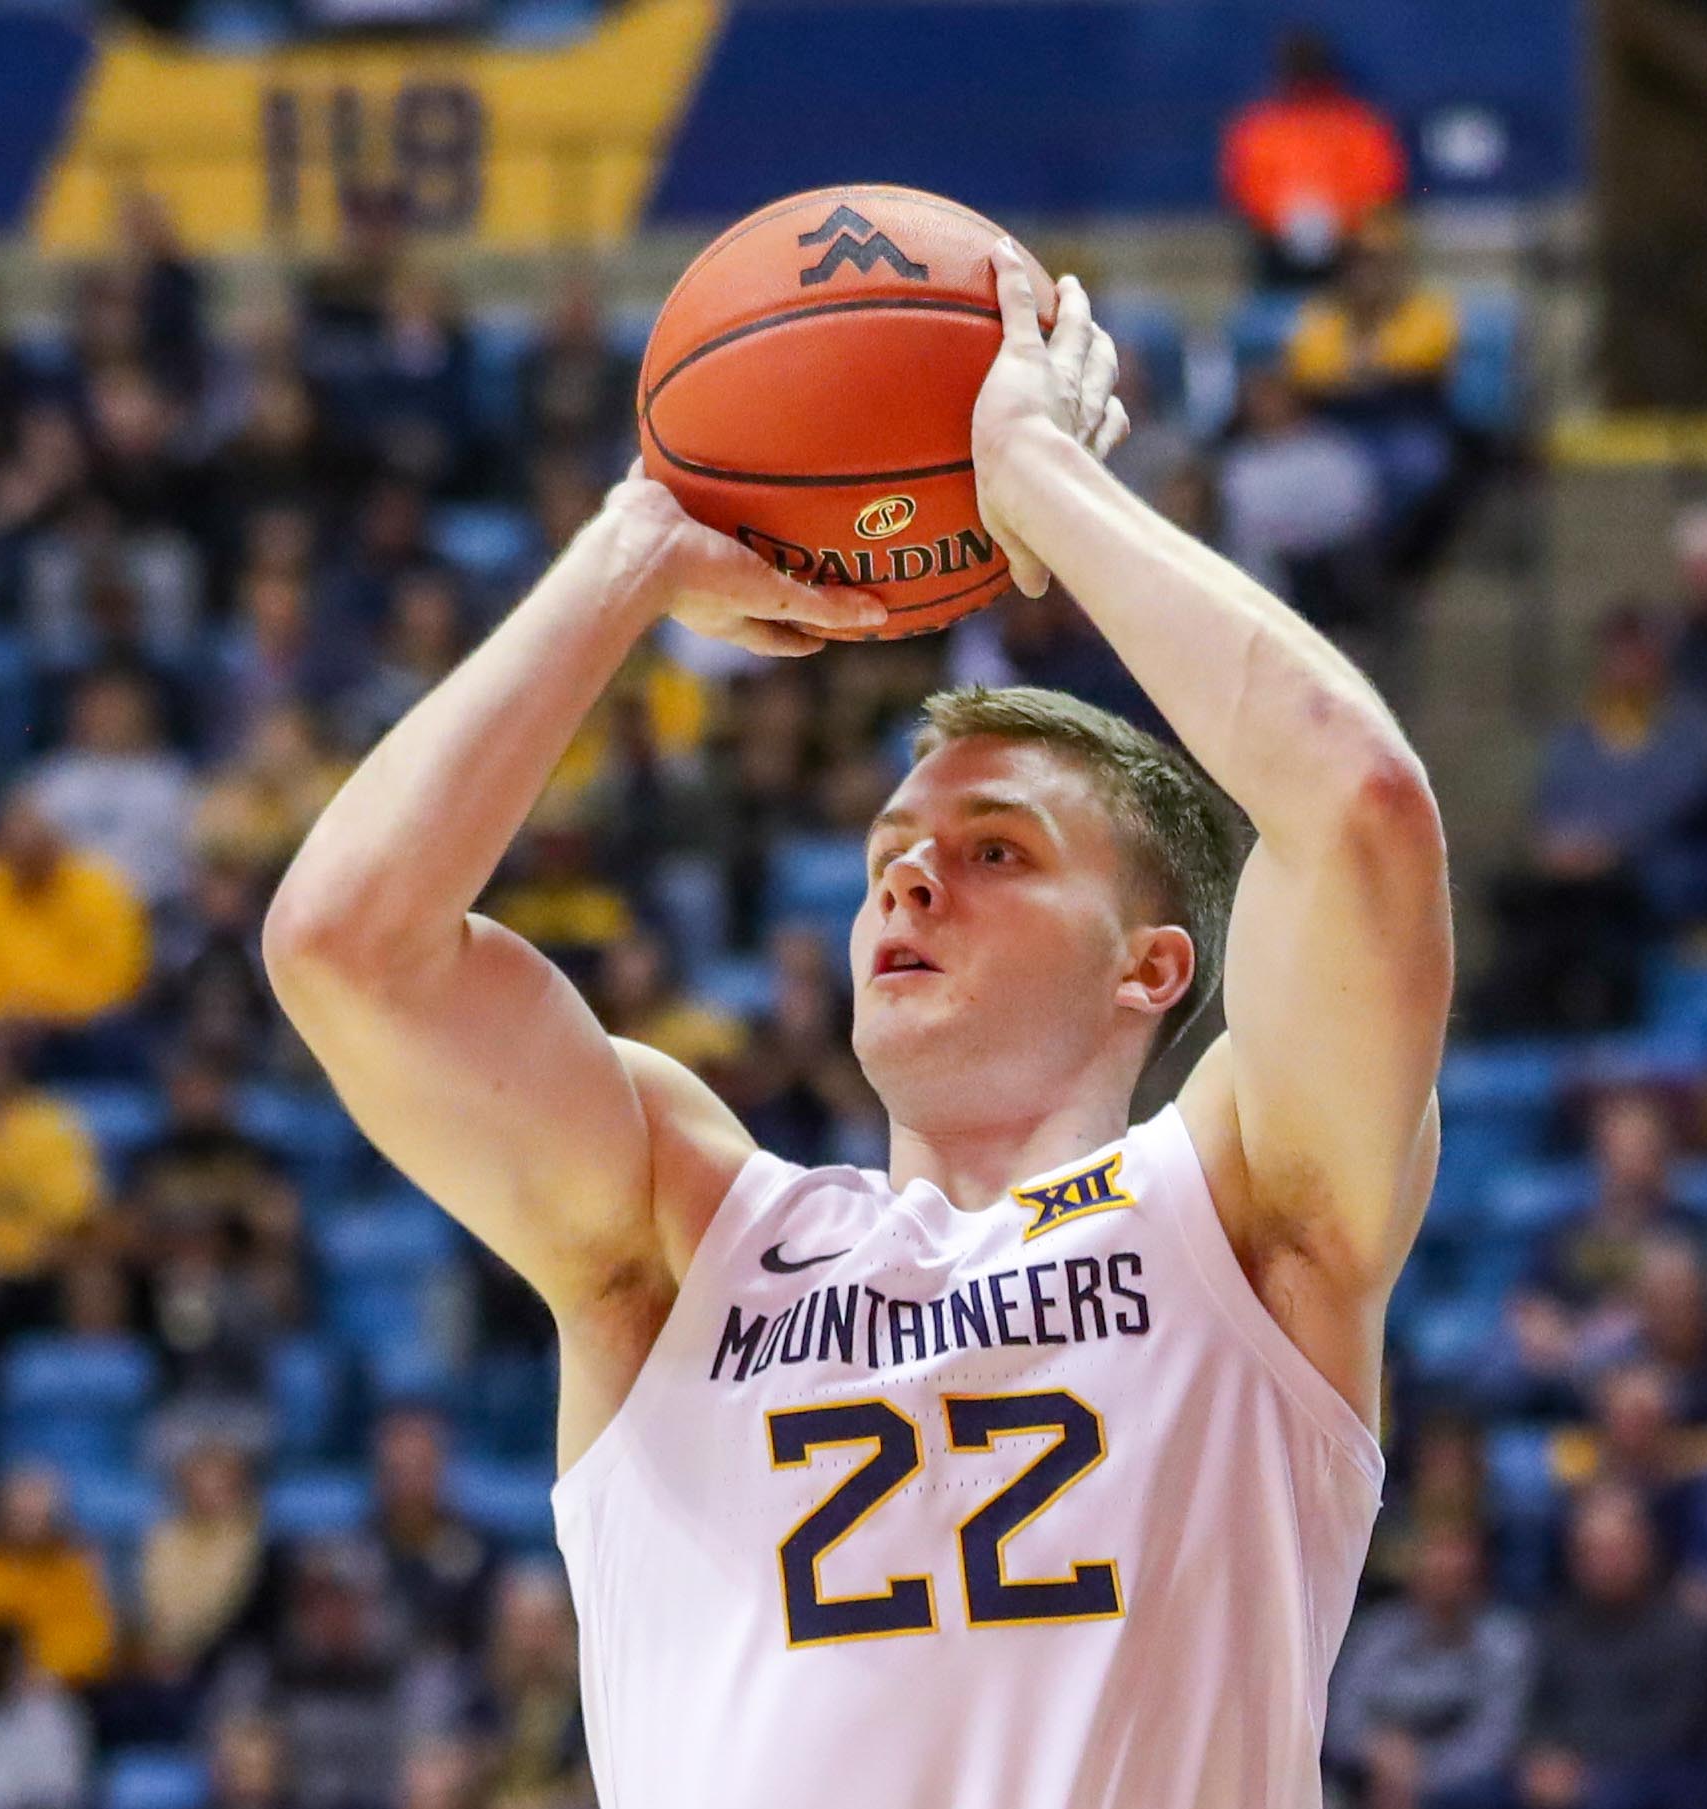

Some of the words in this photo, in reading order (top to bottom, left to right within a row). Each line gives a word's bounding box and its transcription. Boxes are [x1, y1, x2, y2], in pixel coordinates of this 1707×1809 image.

[736, 525, 994, 586] PALDIN
[1016, 1157, 1128, 1234] XII
[710, 1251, 1151, 1381] MOUNTAINEERS
[764, 1388, 1125, 1650] 22
